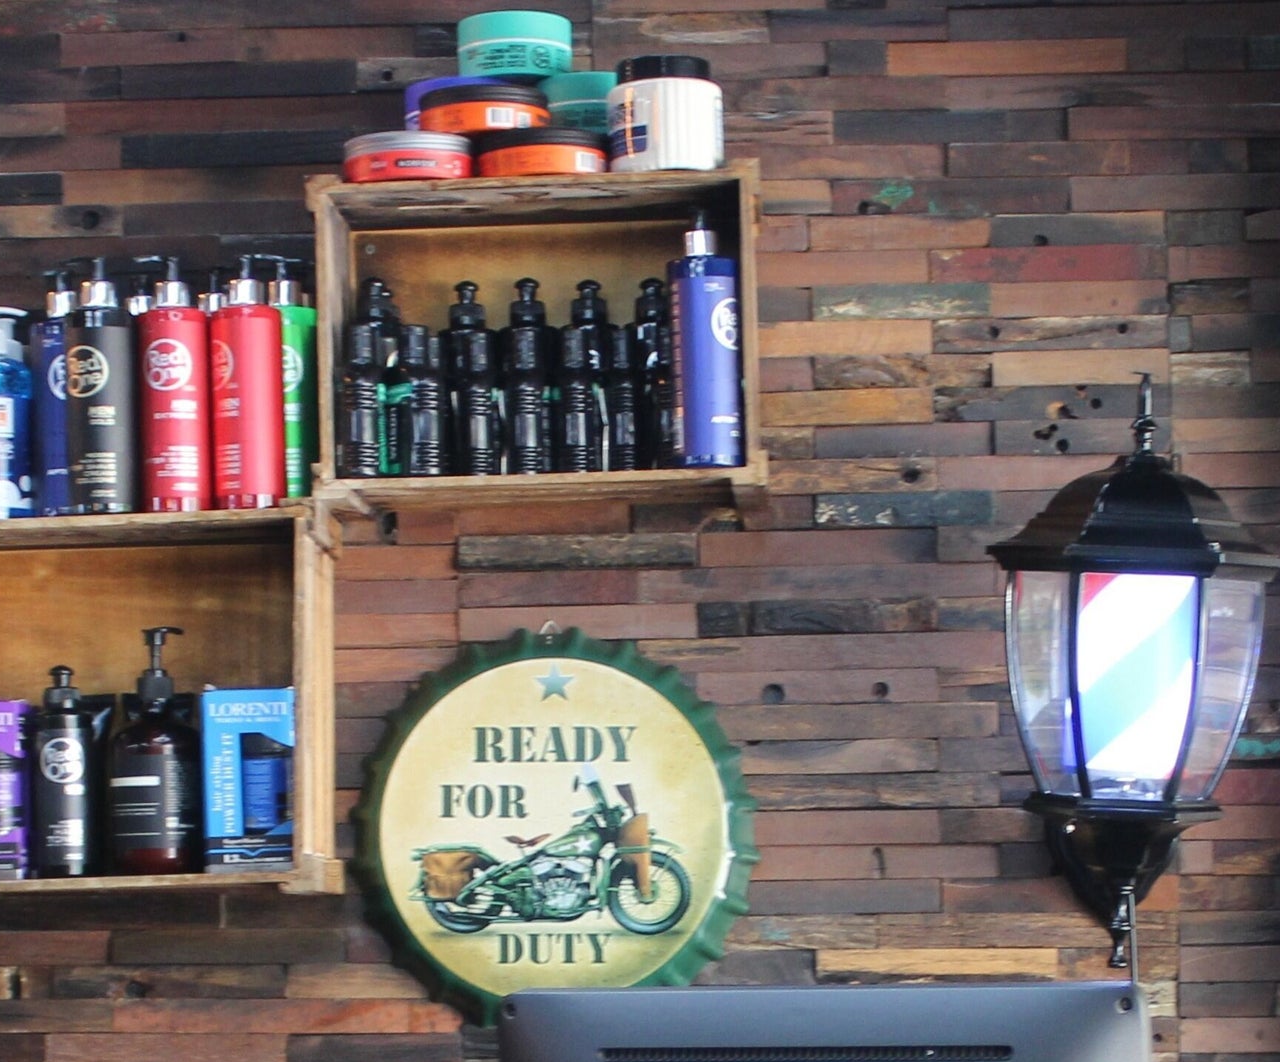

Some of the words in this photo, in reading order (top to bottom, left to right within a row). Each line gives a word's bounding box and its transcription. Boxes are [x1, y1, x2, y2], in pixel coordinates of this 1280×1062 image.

[473, 725, 638, 763] READY
[439, 784, 528, 818] FOR
[497, 933, 613, 964] DUTY
